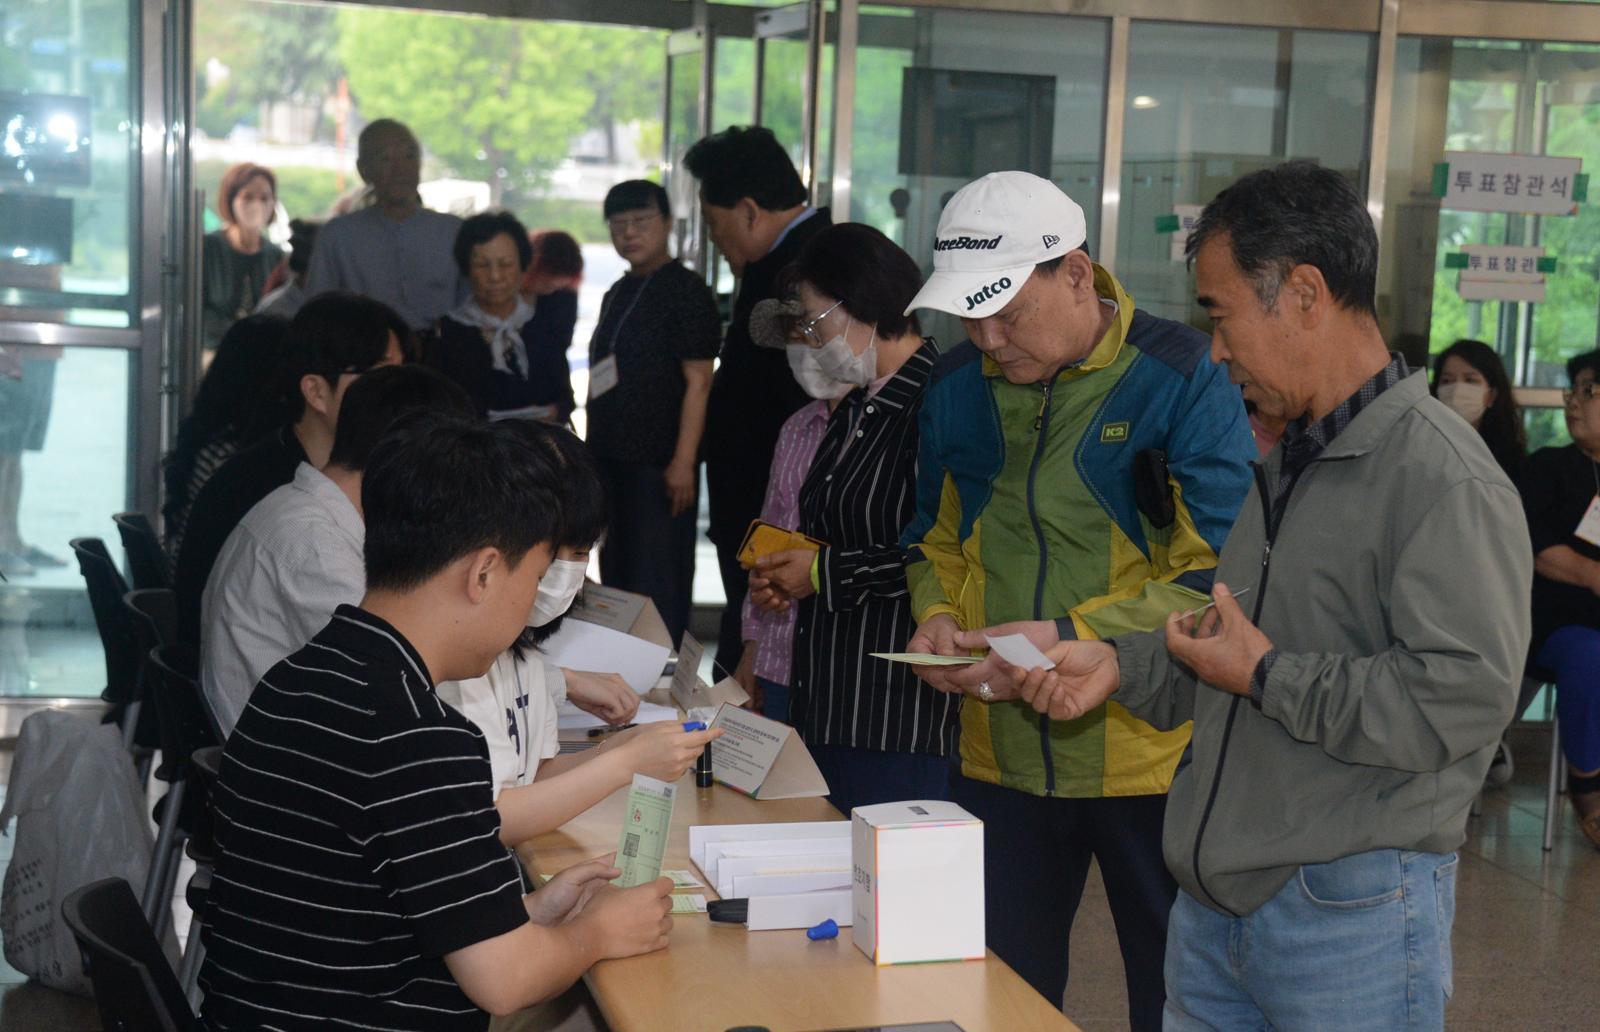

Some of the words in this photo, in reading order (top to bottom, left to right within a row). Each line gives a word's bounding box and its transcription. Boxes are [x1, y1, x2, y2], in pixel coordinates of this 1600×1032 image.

[1454, 170, 1568, 199] 투표참관석
[964, 276, 1012, 311] Jatco
[1105, 427, 1124, 437] K2
